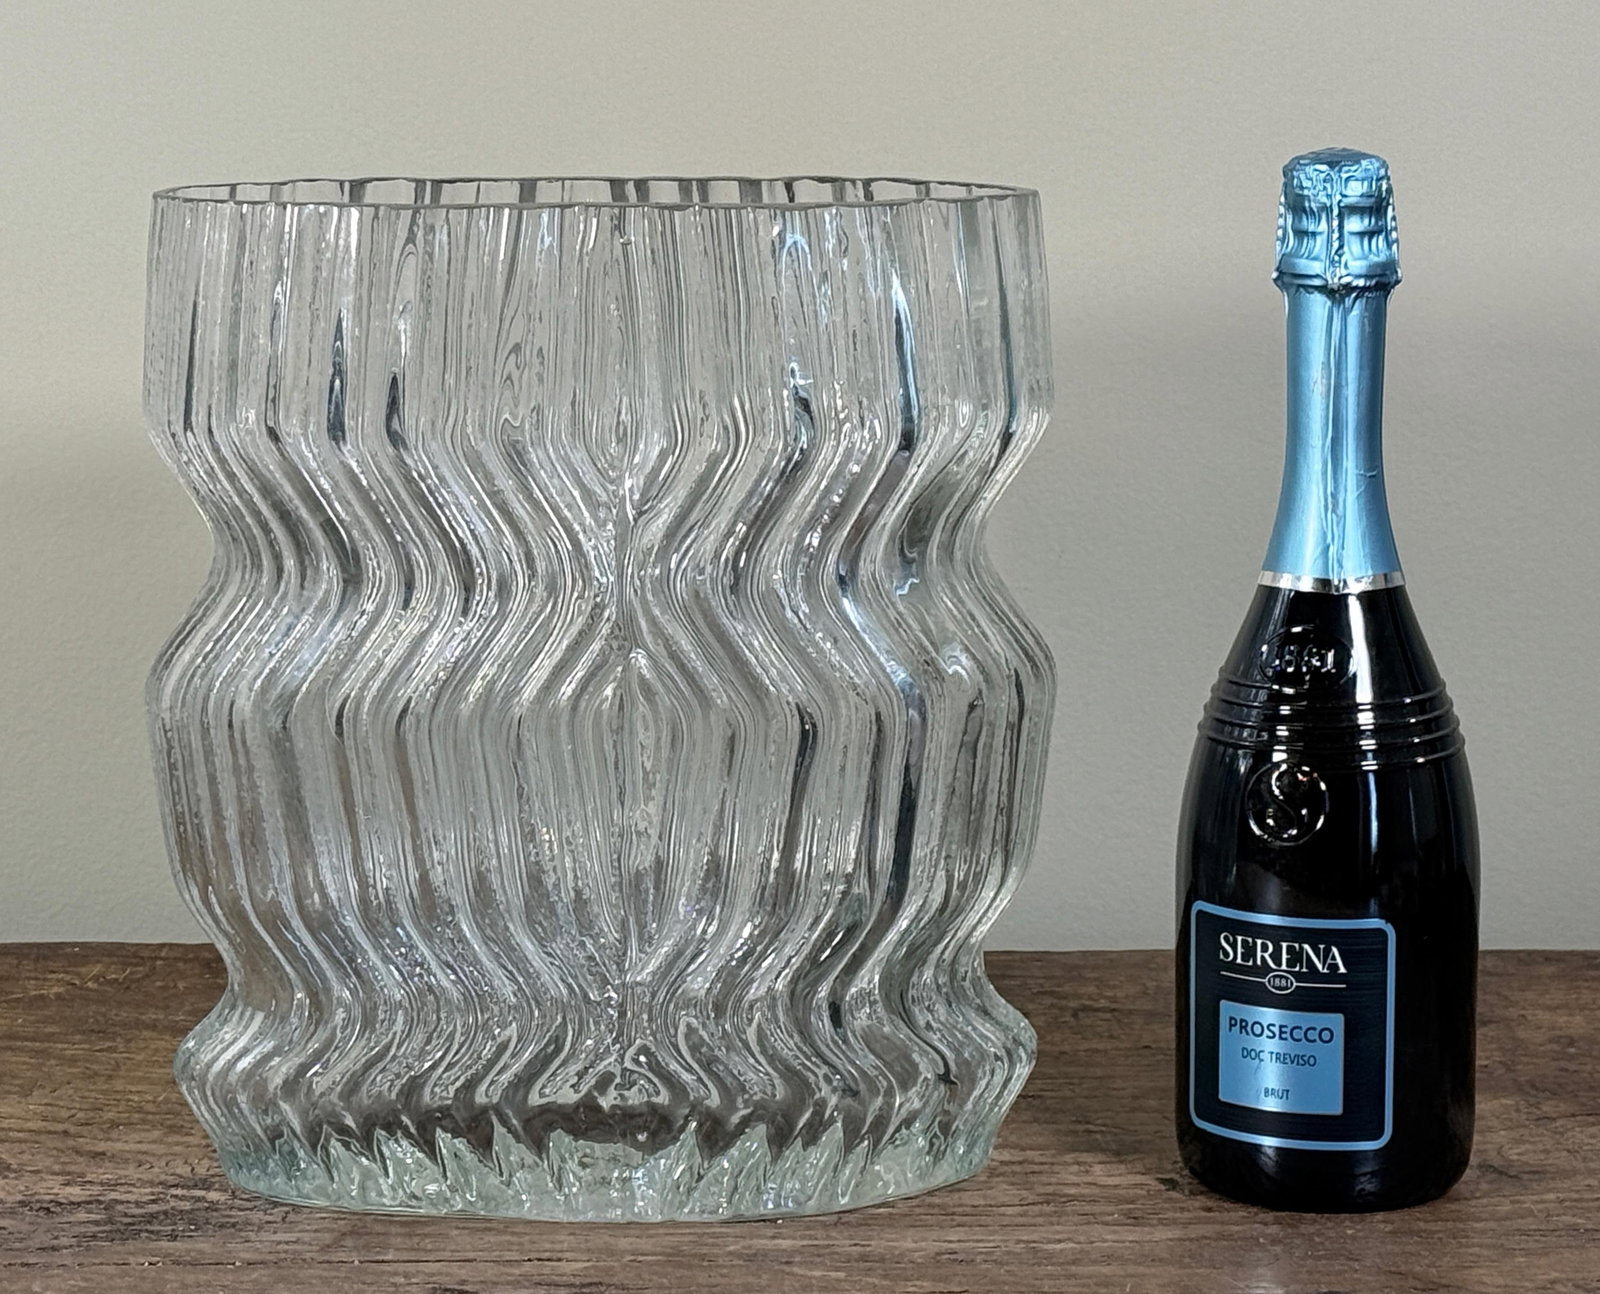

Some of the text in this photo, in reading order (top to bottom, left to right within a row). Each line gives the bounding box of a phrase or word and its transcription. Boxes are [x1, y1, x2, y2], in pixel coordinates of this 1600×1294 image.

[1219, 932, 1347, 973] SERENA
[1270, 977, 1291, 988] 1881
[1229, 1016, 1334, 1044] PROSECCO
[1241, 1047, 1317, 1067] DOC TREVISO
[1264, 1087, 1290, 1100] BRUT
